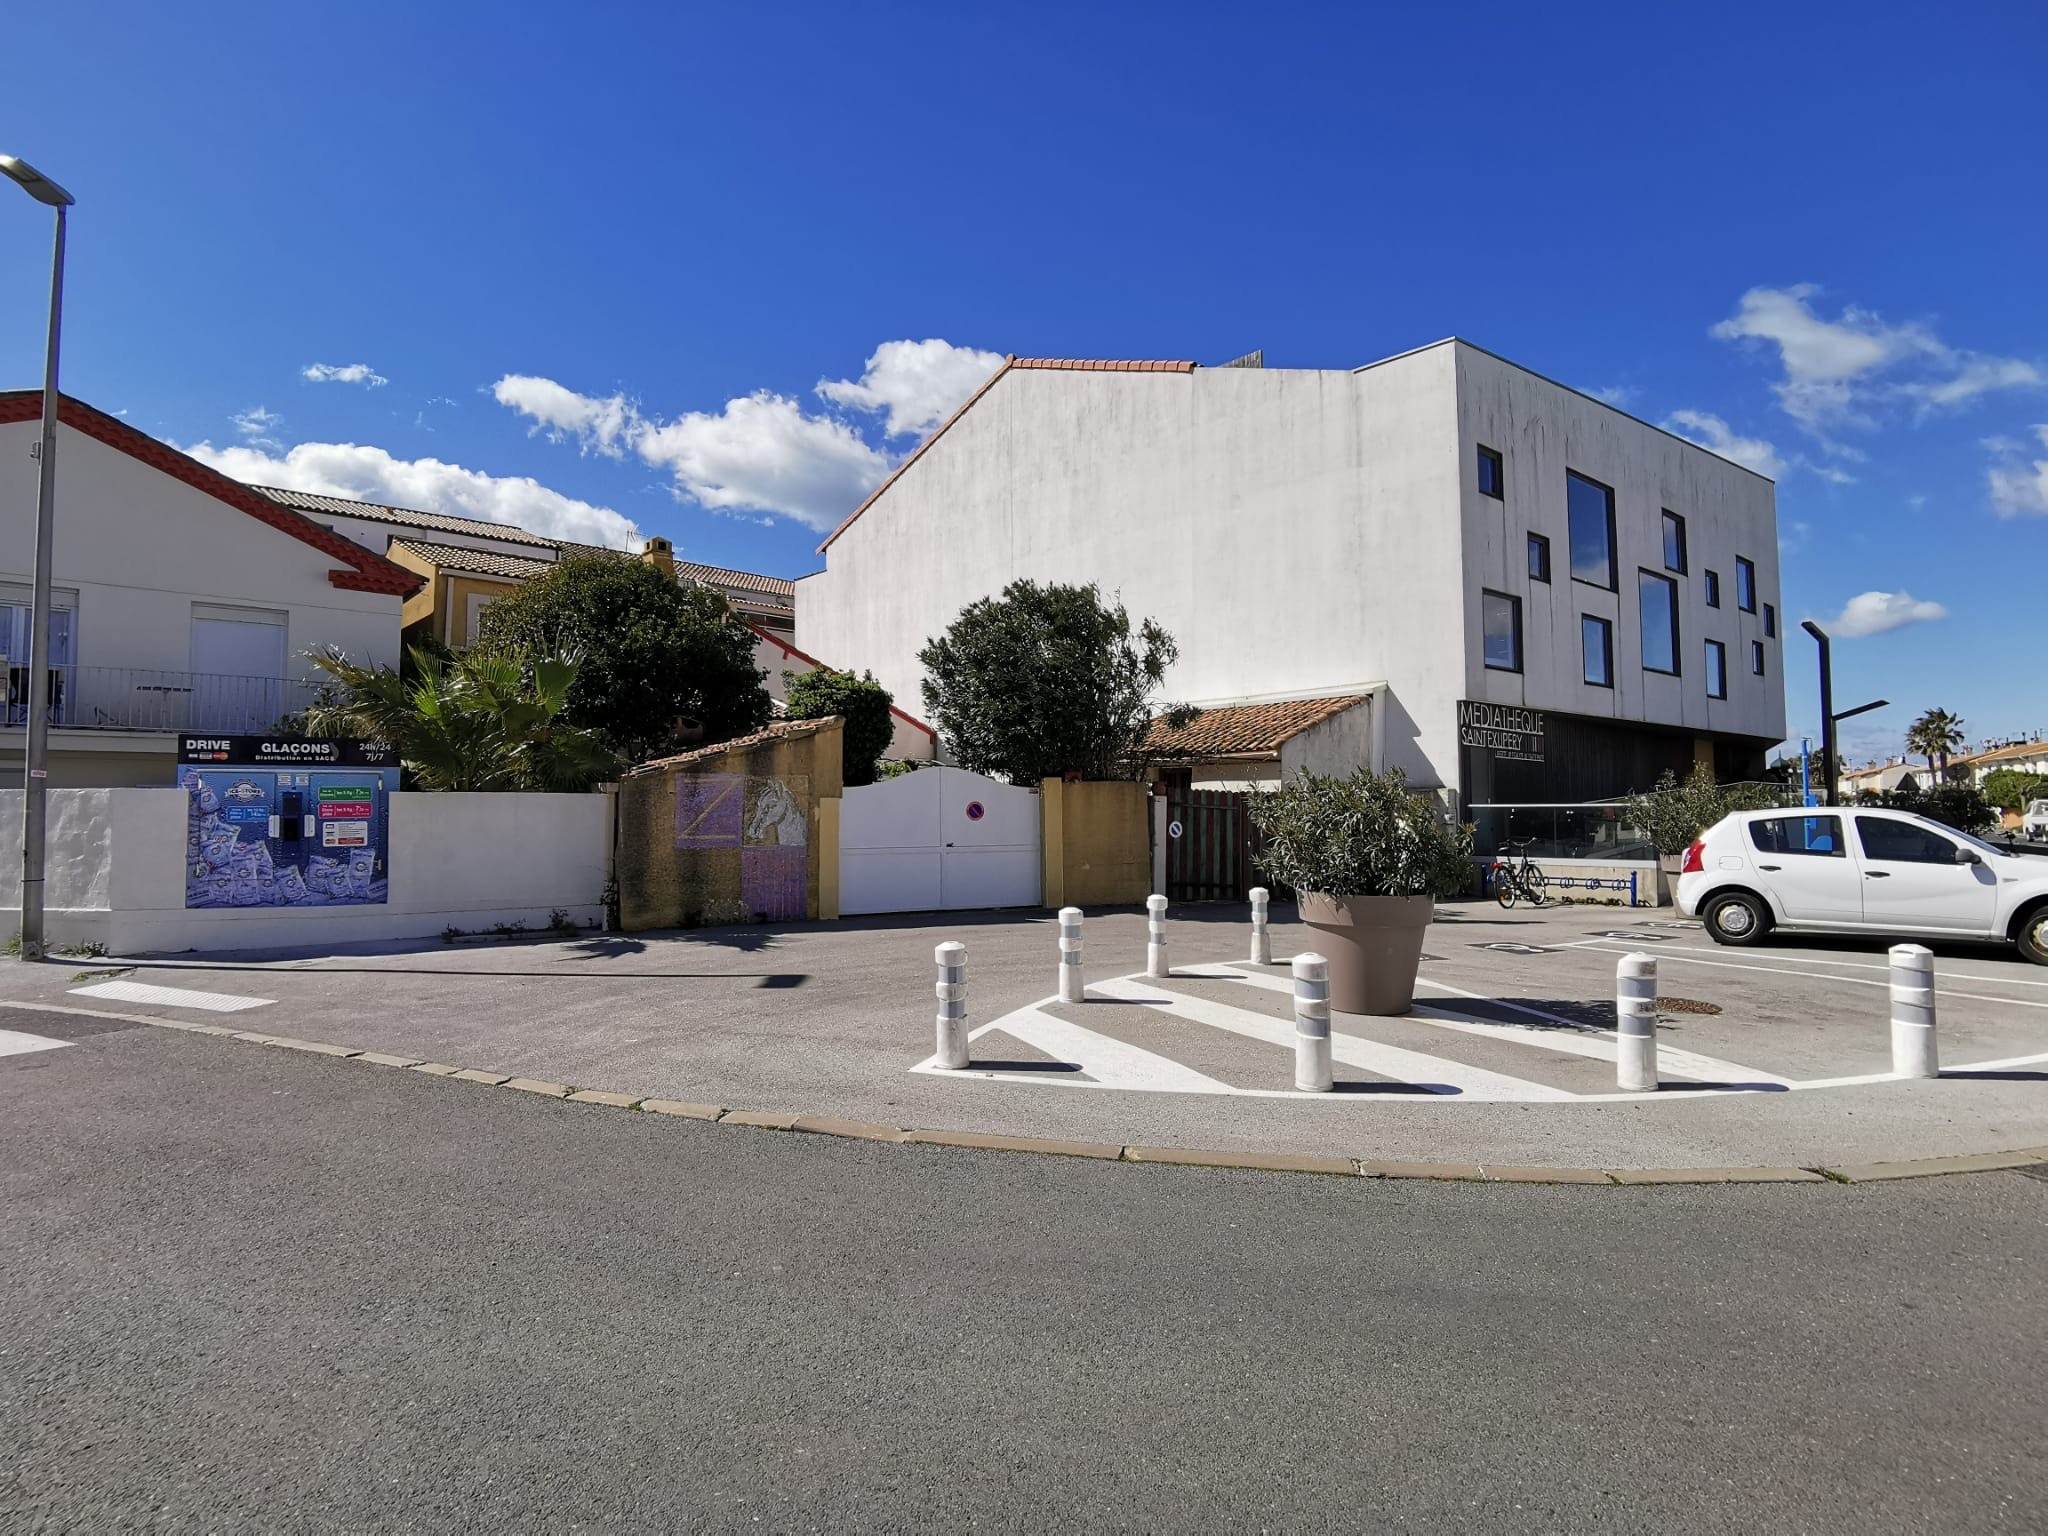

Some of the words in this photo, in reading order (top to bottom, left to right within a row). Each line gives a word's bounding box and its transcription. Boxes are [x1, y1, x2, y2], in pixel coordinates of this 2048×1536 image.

[1460, 701, 1544, 735] MEDIATHEQUE
[1461, 727, 1487, 747] SAINT
[186, 740, 231, 750] DRIVE
[261, 743, 330, 756] GLAÇONS
[366, 753, 384, 762] 7j/7
